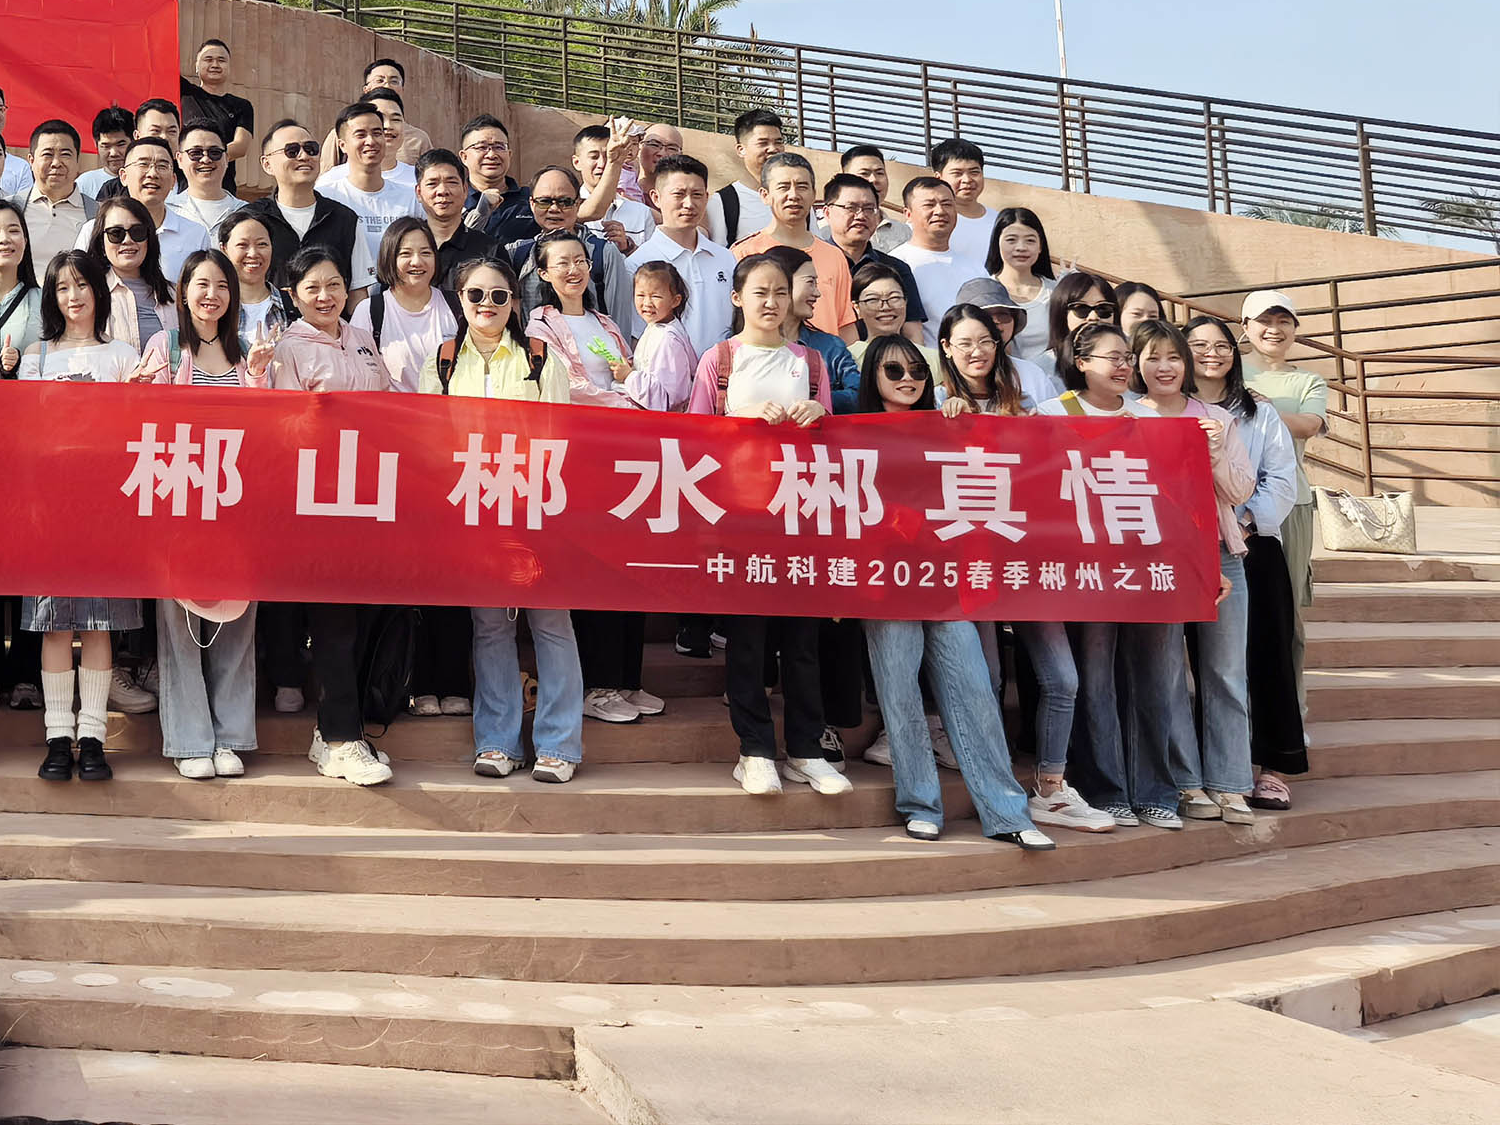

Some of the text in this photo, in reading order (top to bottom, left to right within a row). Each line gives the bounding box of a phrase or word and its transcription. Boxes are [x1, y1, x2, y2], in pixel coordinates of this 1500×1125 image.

[365, 216, 382, 225] THE
[120, 422, 1164, 547] 郴山郴水郴真情
